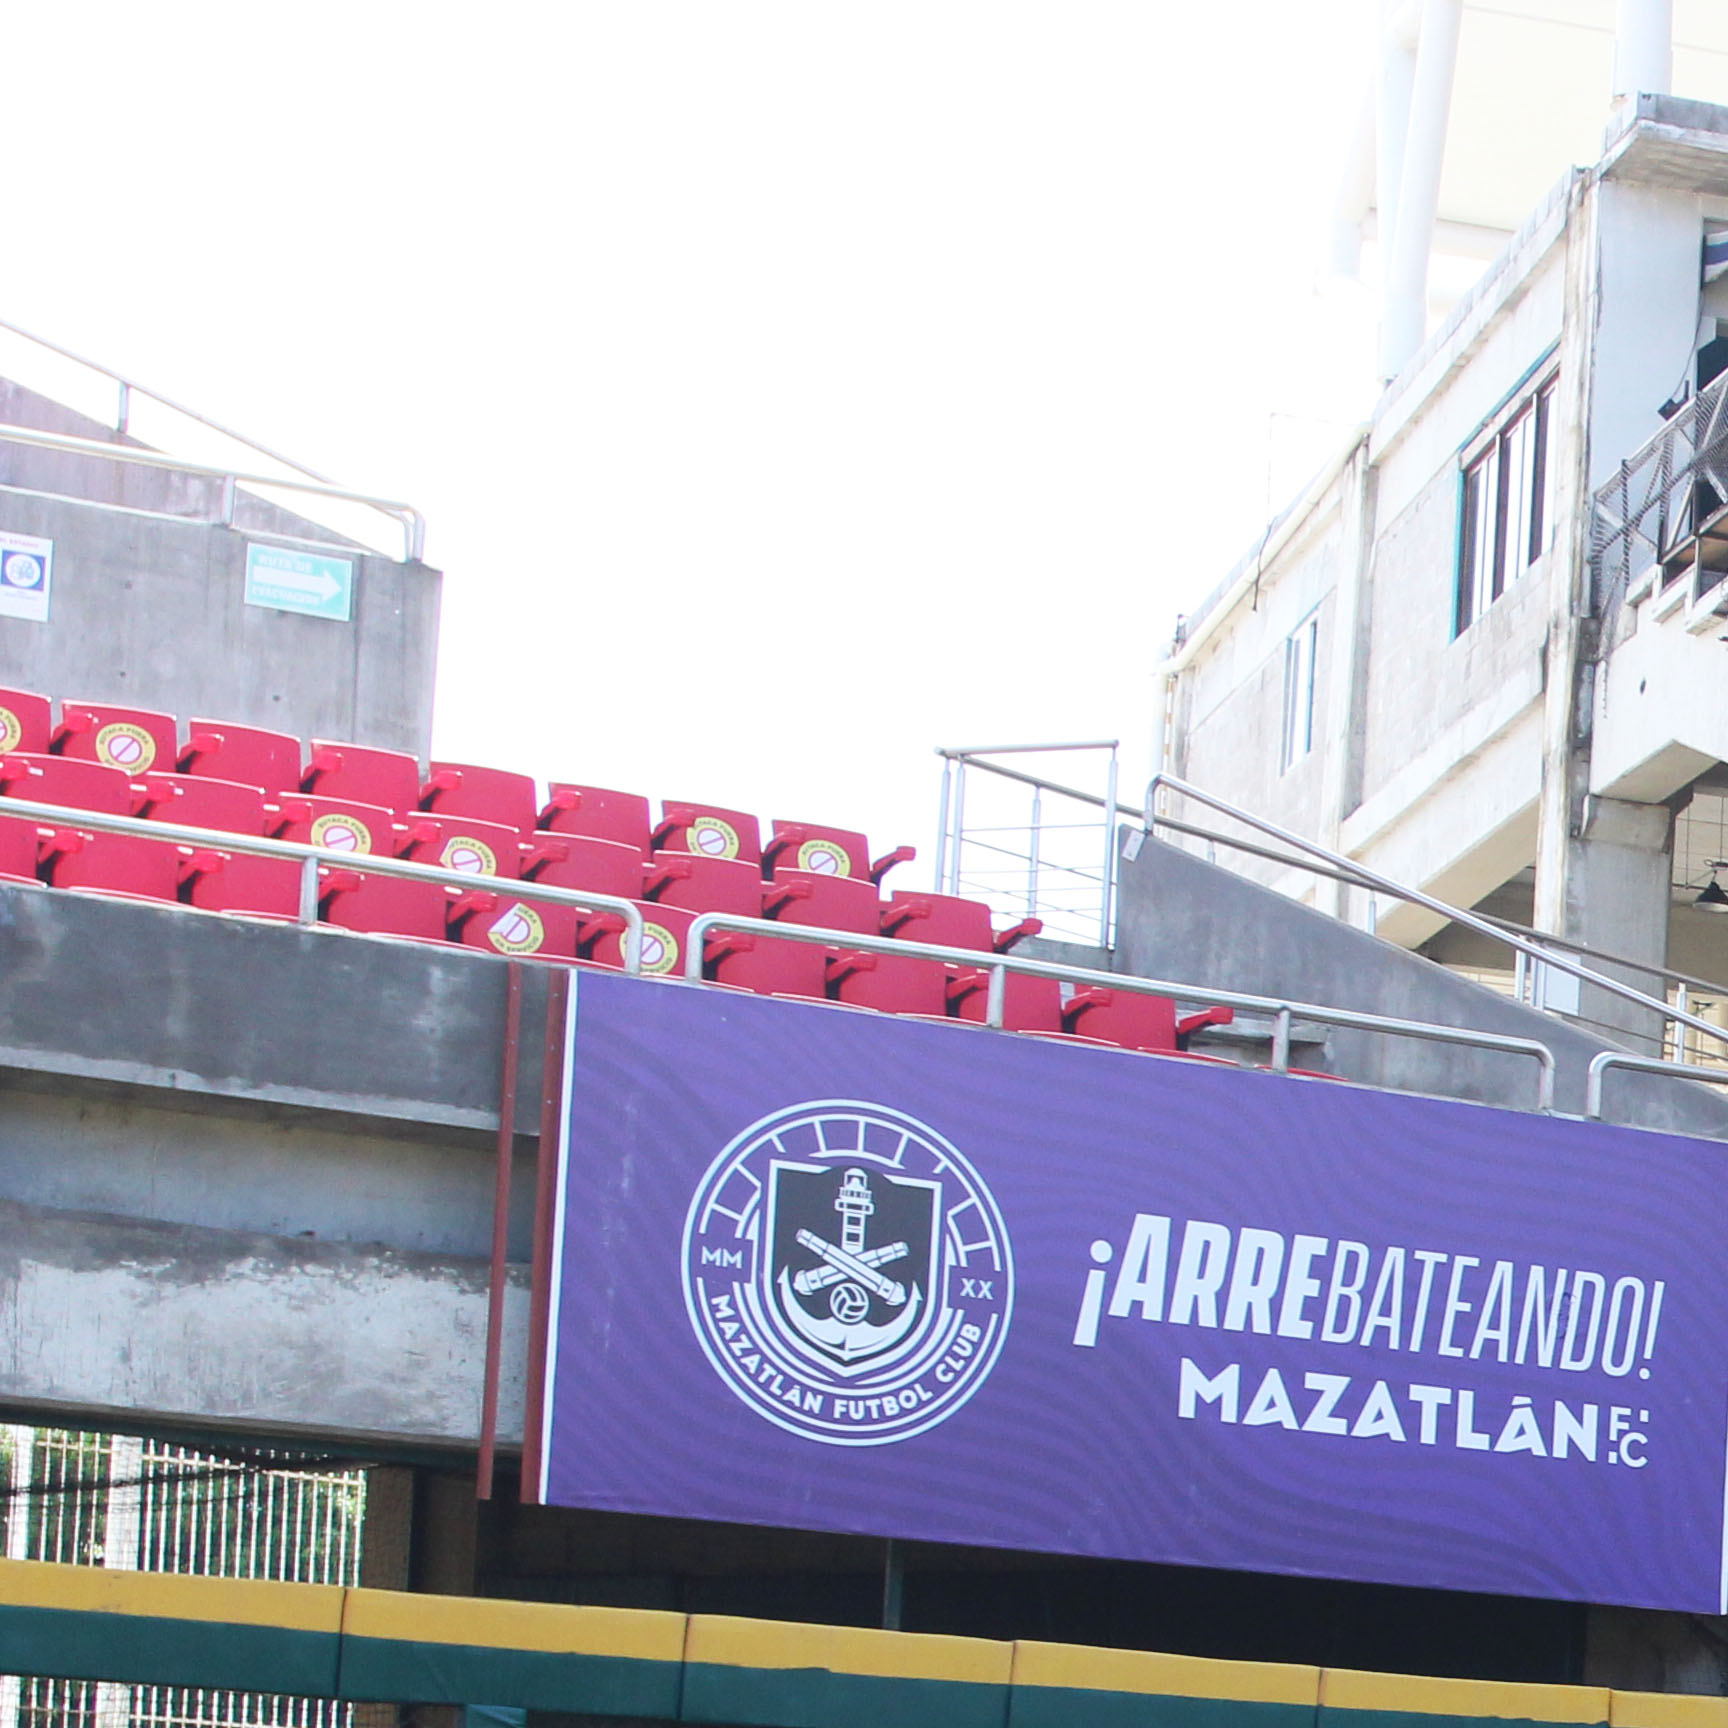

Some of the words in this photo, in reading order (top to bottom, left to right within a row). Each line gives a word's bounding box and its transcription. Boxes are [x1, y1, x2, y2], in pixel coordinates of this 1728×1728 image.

[700, 1246, 744, 1269] MM
[959, 1278, 994, 1300] XX
[1073, 1212, 1666, 1380] ¡ARREBATEANDO!
[711, 1293, 824, 1415] MAZATLÁN
[833, 1383, 934, 1420] FUTBOL
[935, 1322, 983, 1385] CLUB
[1177, 1357, 1600, 1463] MAZATLÁN
